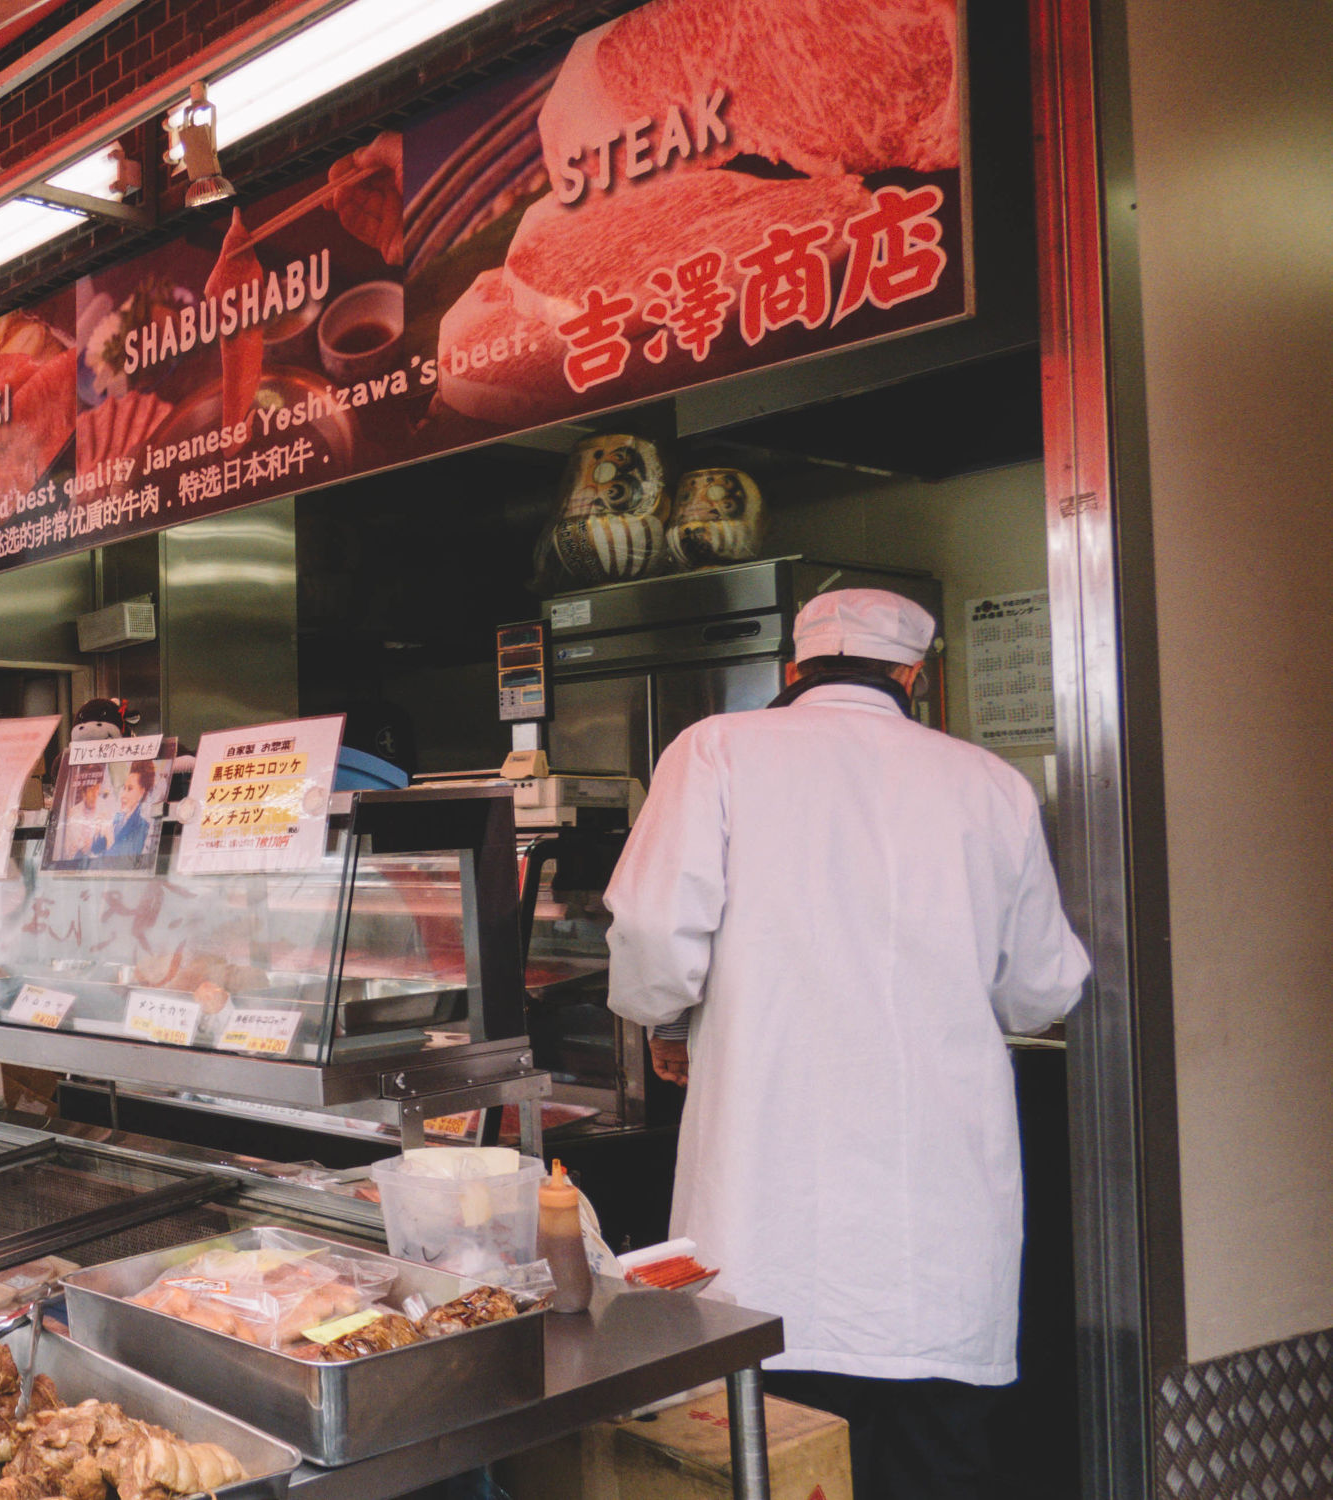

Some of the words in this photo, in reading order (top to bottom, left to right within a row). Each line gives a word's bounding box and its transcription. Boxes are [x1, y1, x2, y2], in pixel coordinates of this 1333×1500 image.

[557, 87, 728, 204] STEAK
[123, 248, 330, 374] SHABUSHABU
[557, 185, 948, 393] 吉澤商店
[16, 478, 57, 513] best
[63, 456, 137, 499] quality
[256, 355, 438, 436] Yoshizawa's
[206, 784, 270, 804] メンチカツ
[212, 758, 302, 782] 黒毛和牛コロッケ
